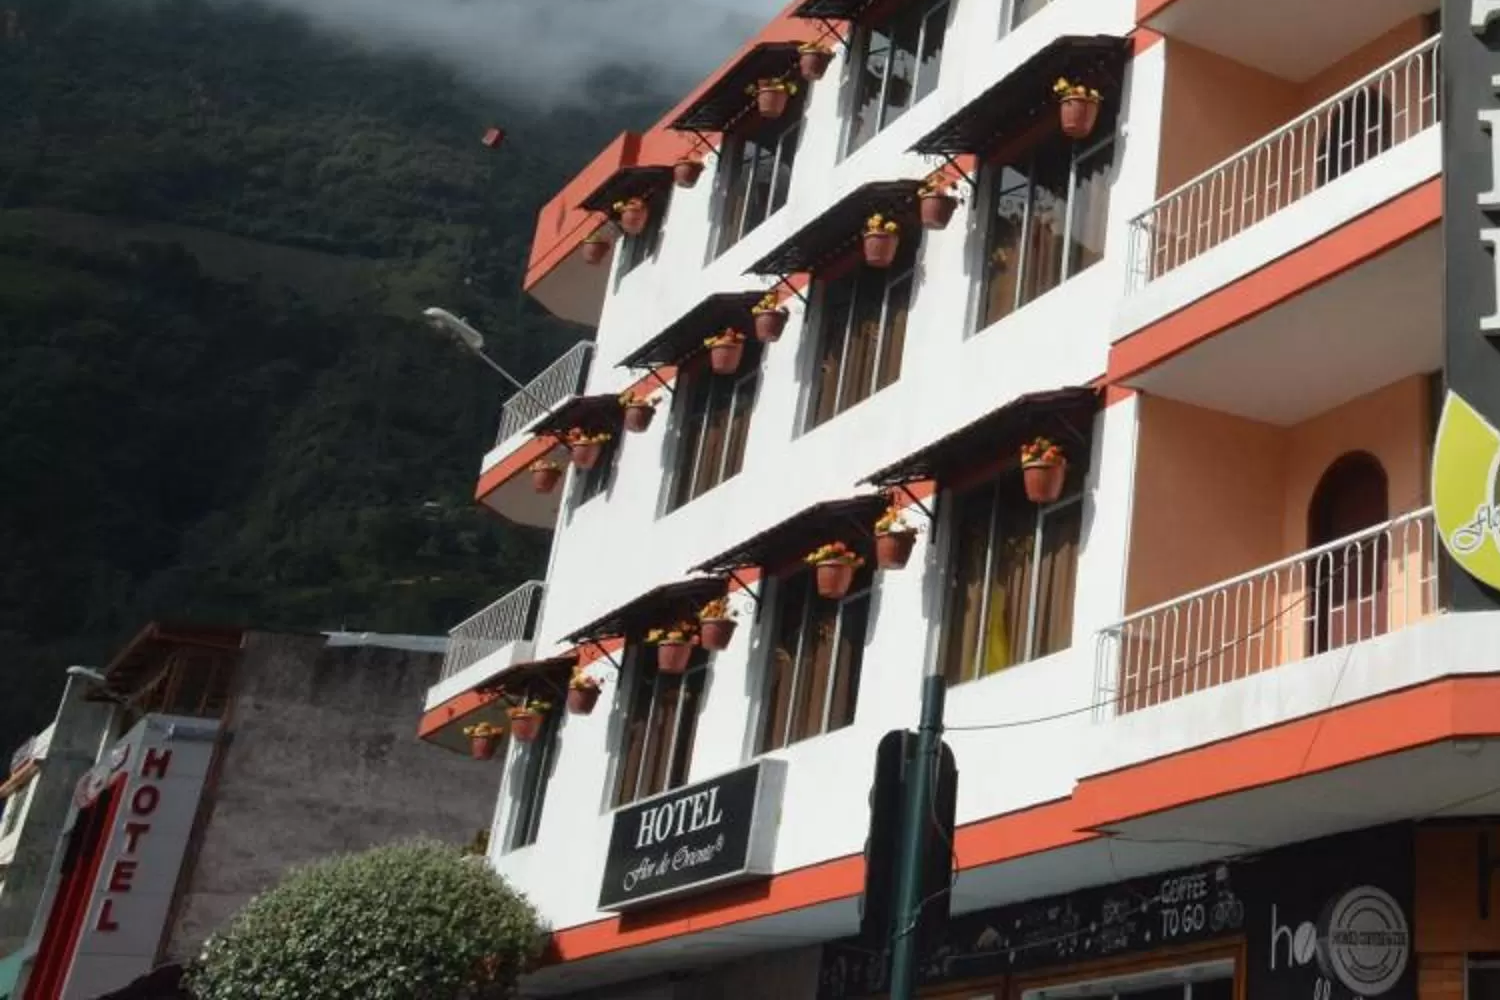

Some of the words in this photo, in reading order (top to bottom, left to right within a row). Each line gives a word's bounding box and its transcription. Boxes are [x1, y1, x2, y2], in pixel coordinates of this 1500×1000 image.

[96, 748, 173, 931] HOTEL
[635, 786, 723, 849] HOTEL
[1161, 872, 1207, 903] COFFEE
[1161, 906, 1180, 937] TO
[1182, 903, 1205, 933] GO
